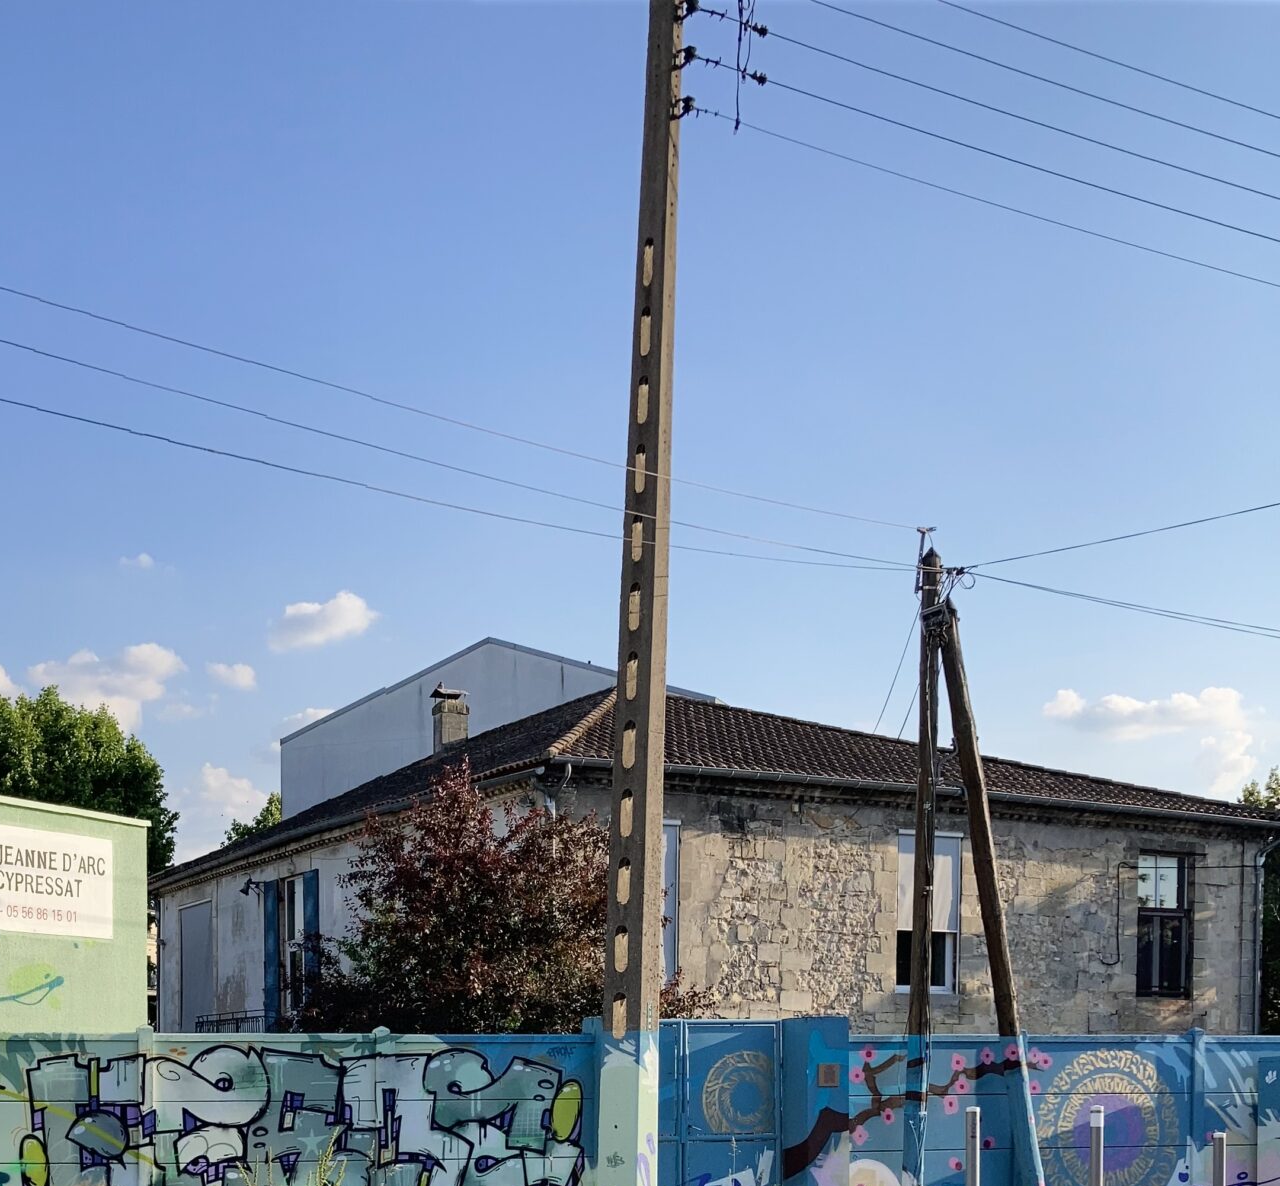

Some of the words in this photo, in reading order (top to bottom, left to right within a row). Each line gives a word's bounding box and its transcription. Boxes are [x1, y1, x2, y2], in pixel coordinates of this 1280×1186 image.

[62, 853, 106, 876] D'ARC
[6, 905, 19, 918] 05
[22, 906, 34, 919] 56
[36, 907, 48, 921] 86
[52, 909, 63, 922] 15
[66, 910, 78, 923] 01
